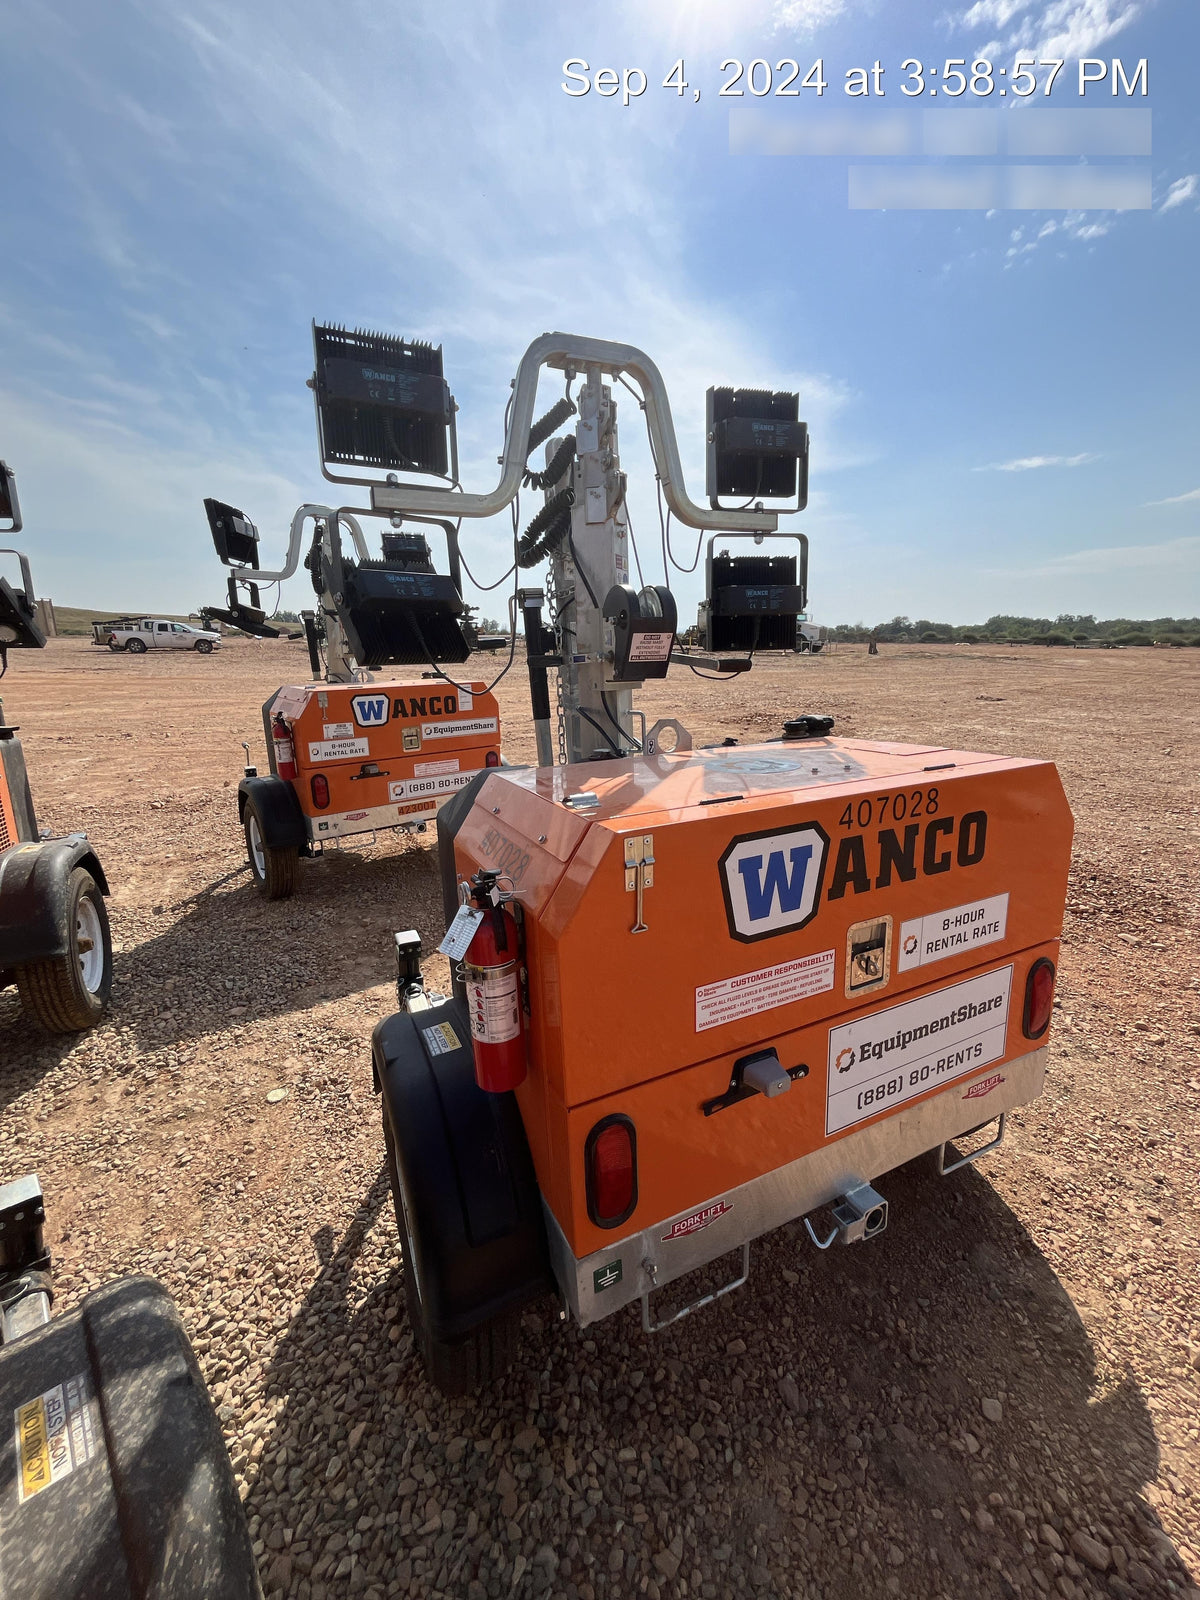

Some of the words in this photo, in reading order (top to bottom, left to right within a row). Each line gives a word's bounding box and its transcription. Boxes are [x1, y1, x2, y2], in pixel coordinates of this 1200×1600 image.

[356, 696, 457, 722] WANCO
[433, 722, 494, 734] EquipmentShare
[409, 782, 436, 793] (888)
[399, 801, 436, 815] 423007
[839, 788, 940, 830] 407028
[737, 810, 988, 922] WANCO
[942, 908, 986, 931] 8-HOUR
[926, 932, 970, 955] RENTAL
[972, 920, 1000, 940] RATE
[730, 970, 773, 989] CUSTOMER
[774, 953, 834, 976] RESPONSIBILITY
[701, 1001, 718, 1011] CHECK
[727, 994, 741, 1003] FLUID
[741, 990, 758, 1000] LEVELS
[763, 983, 780, 992] GREASE
[709, 1004, 737, 1017] INSURANCE
[778, 986, 797, 995] DAMAGE
[698, 1018, 720, 1028] DAMAGE
[727, 1006, 755, 1020] EQUIPMENT
[858, 995, 1003, 1063] EquipmentShare
[439, 1038, 448, 1048] STEP
[857, 1076, 903, 1110] (888)
[909, 1042, 983, 1086] 80-RENTS
[970, 1083, 986, 1095] FORK
[986, 1075, 1000, 1087] LIFT
[674, 1213, 701, 1233] FORK
[702, 1203, 722, 1220] LIFT
[47, 1398, 63, 1429] STEP
[23, 1405, 43, 1473] CAUTION
